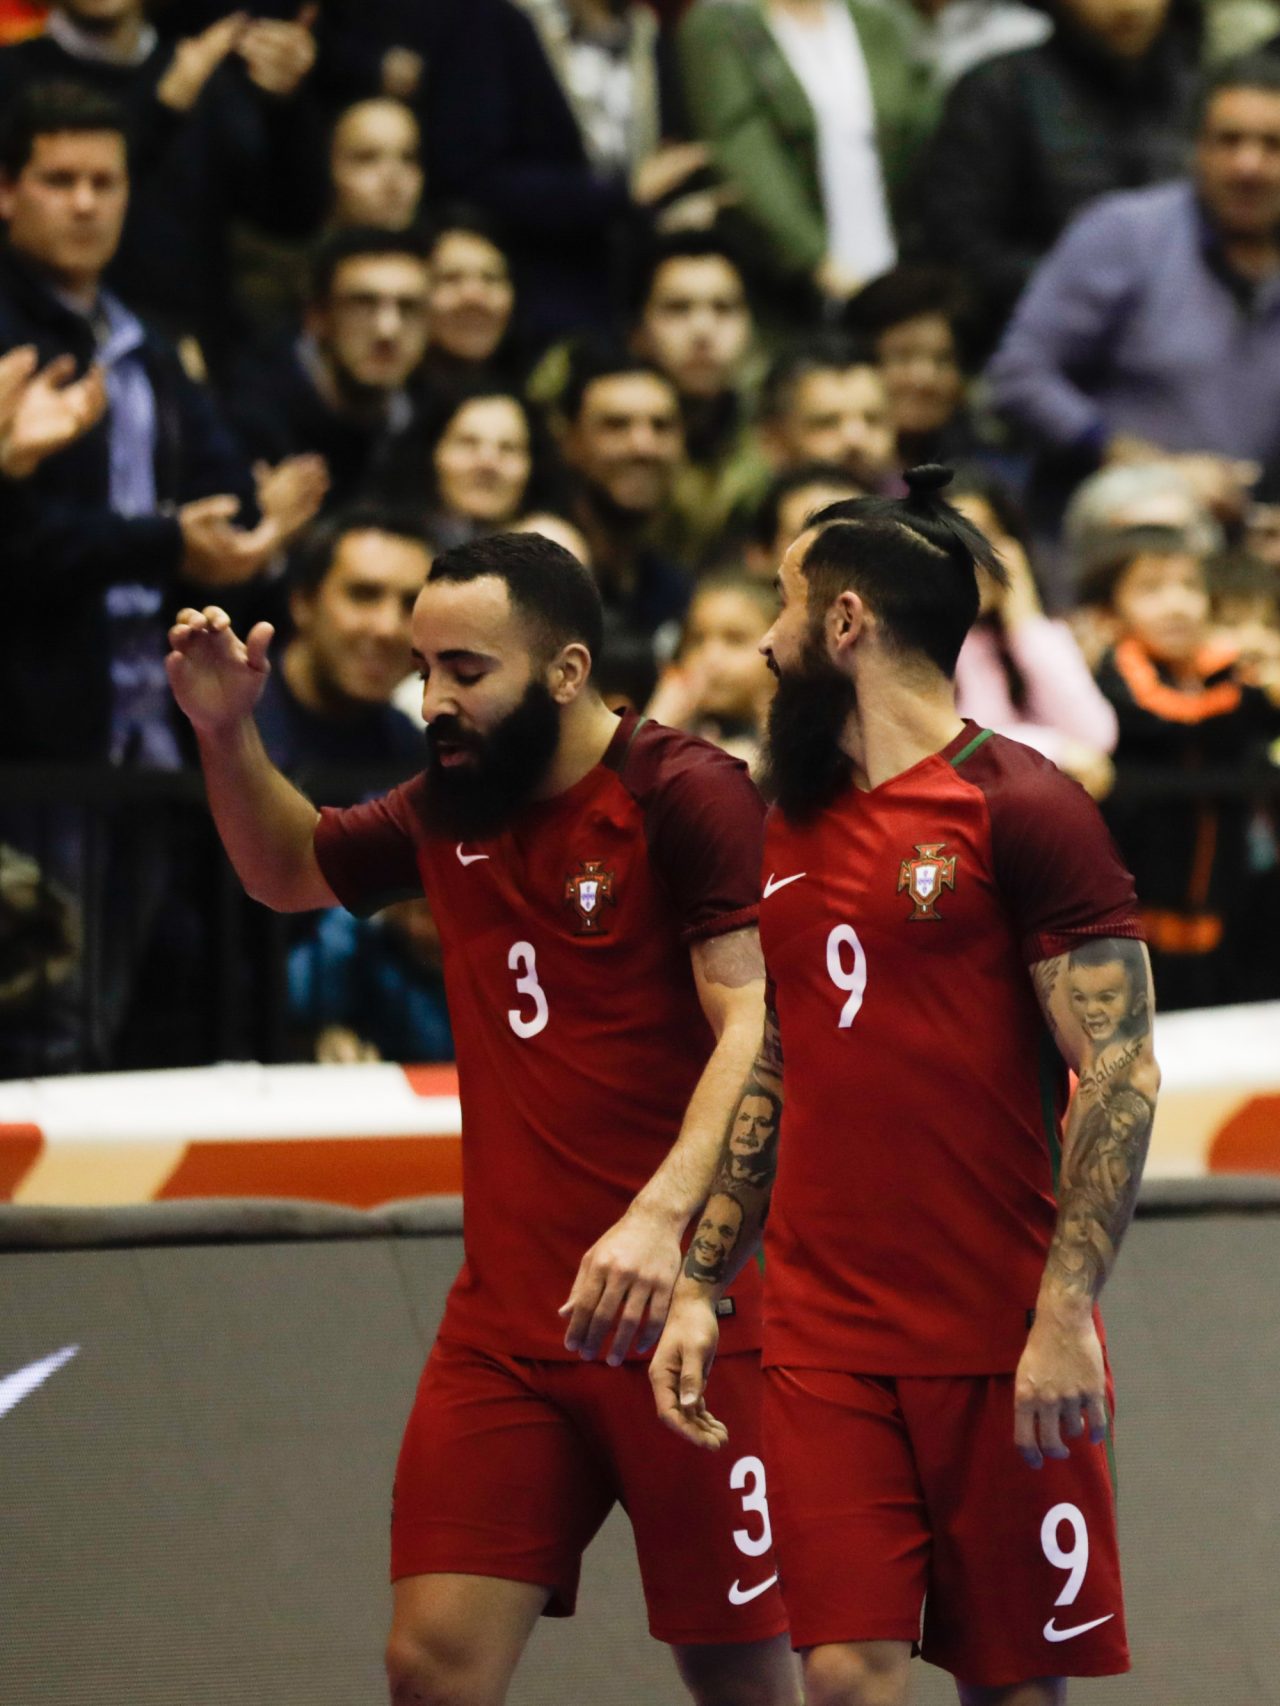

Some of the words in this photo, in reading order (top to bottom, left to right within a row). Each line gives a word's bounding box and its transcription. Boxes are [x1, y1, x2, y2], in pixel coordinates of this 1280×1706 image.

[508, 941, 549, 1039] 3
[826, 923, 868, 1029] 9
[730, 1455, 773, 1557] 3
[1040, 1502, 1089, 1607] 9
